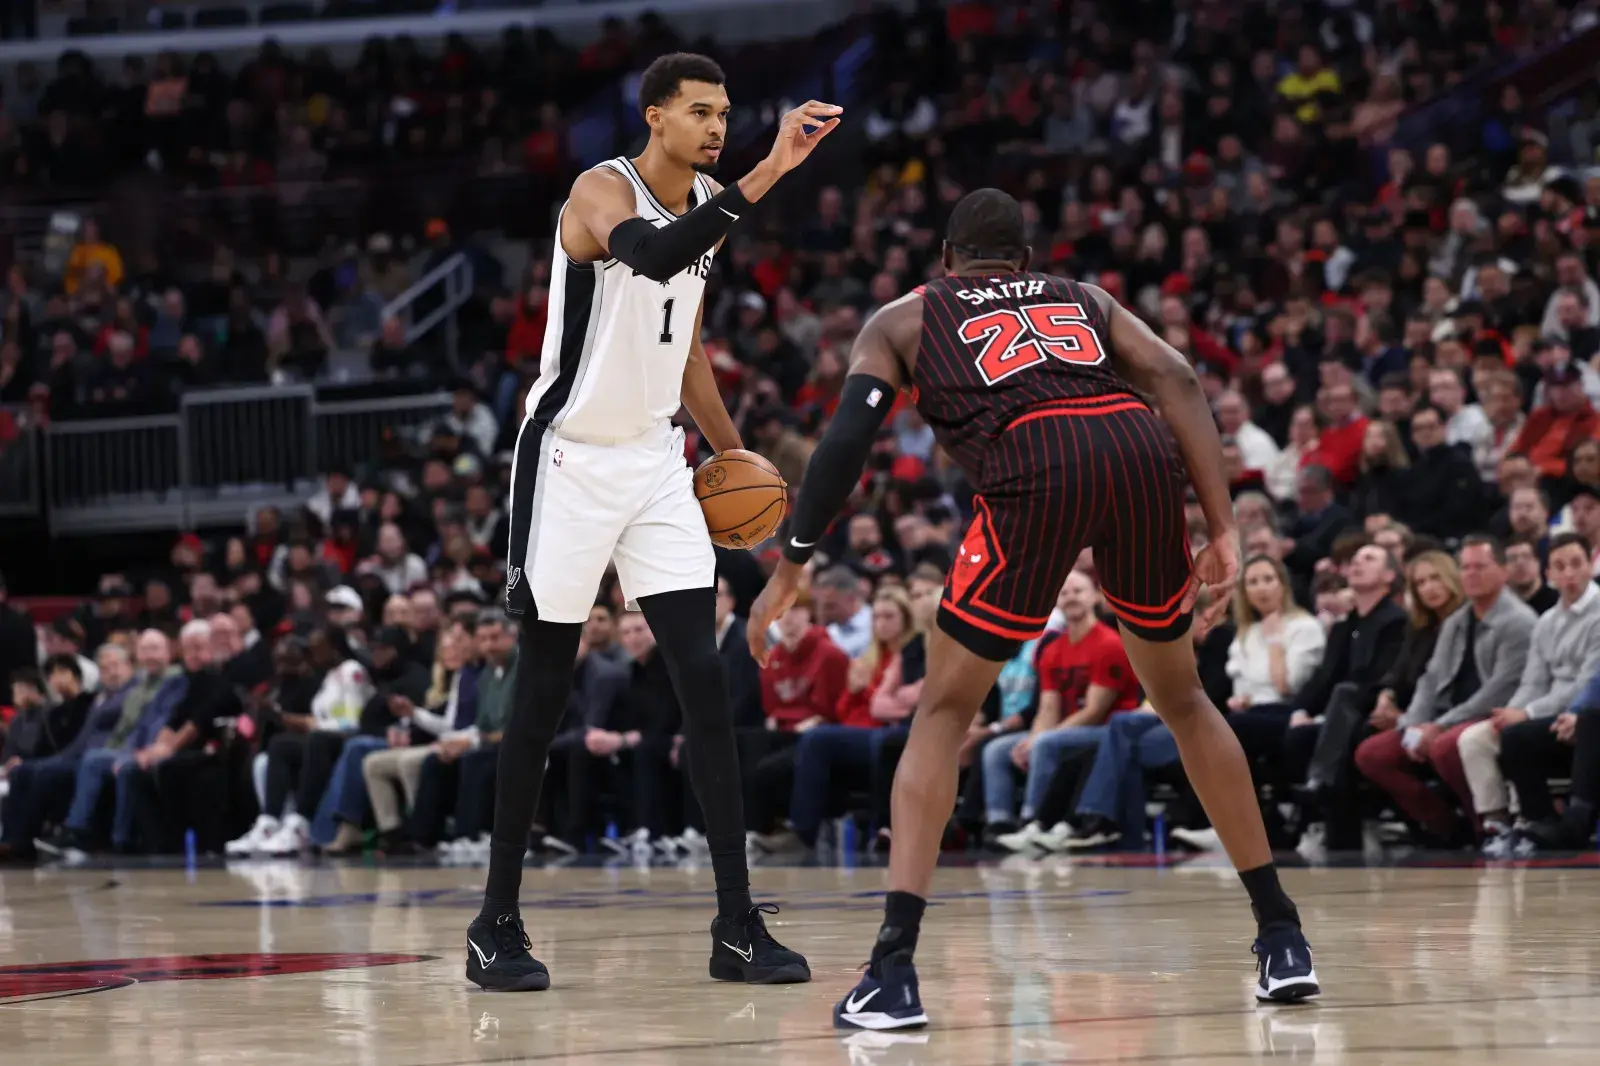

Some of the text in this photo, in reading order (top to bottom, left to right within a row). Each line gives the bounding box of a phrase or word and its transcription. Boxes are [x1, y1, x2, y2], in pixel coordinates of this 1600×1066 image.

[956, 279, 1046, 305] SMITH
[658, 297, 676, 345] 1
[958, 303, 1106, 386] 25
